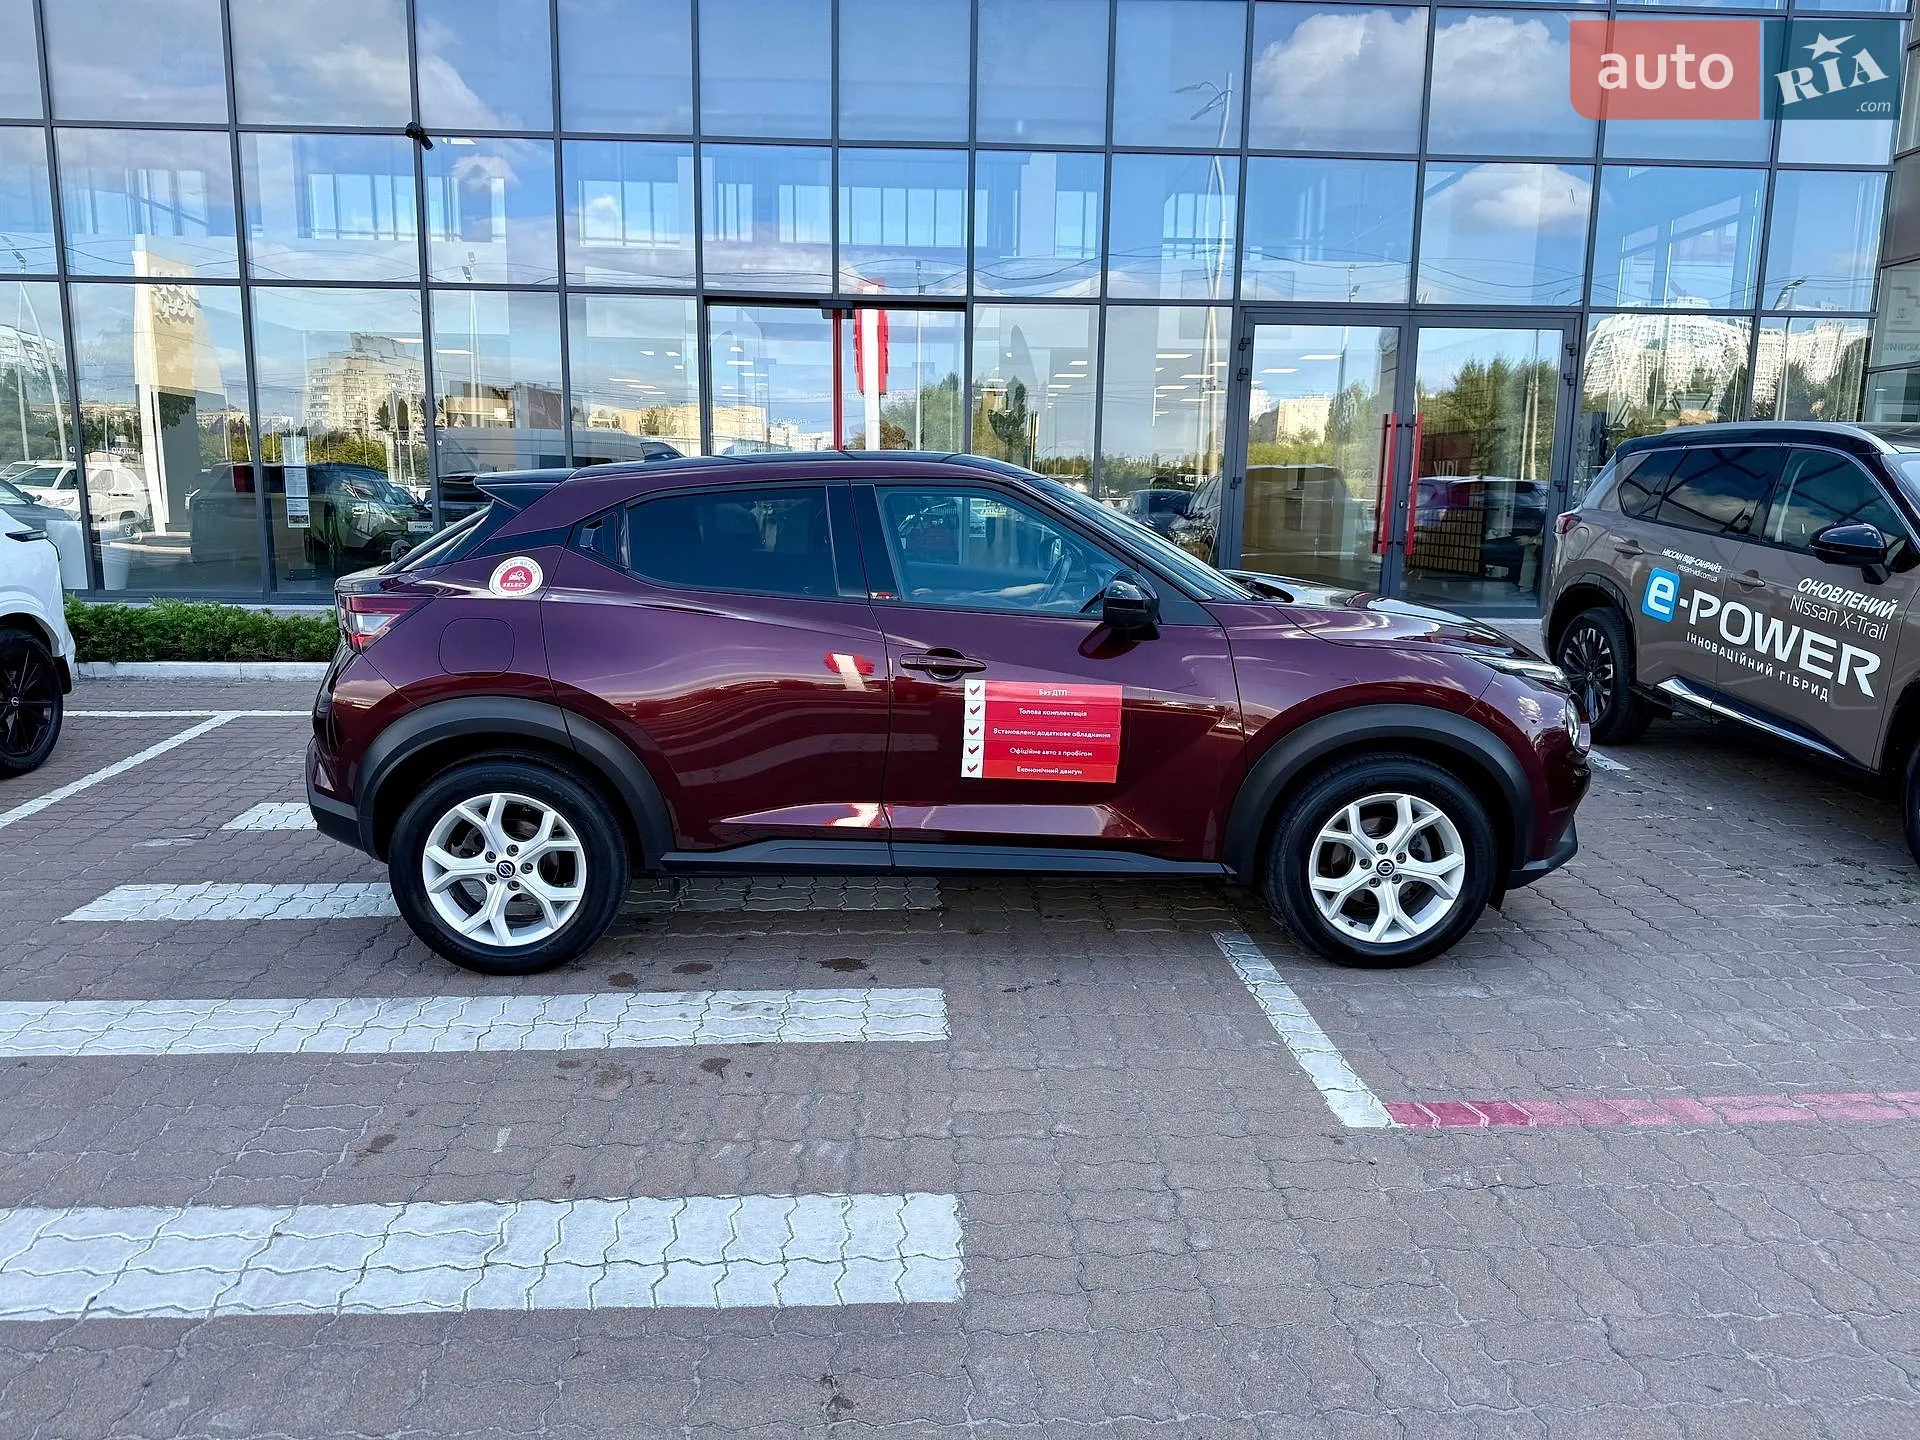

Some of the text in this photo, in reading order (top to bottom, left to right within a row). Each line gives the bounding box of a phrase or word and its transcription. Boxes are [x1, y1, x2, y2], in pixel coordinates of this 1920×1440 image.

[1797, 577, 1899, 620] ОНОВЛЕНИЙ
[1789, 594, 1889, 641] Nissan X-Trail
[1646, 576, 1881, 698] e-POWER
[1686, 631, 1829, 703] ІННОВАЦІЙНИЙ ГІБРИД
[1039, 688, 1068, 697] Без ДТП
[1018, 707, 1087, 718] Топова комплектація
[993, 728, 1111, 739] Встановлено додаткове обладнання
[1009, 747, 1041, 755] Офіційне
[1016, 765, 1083, 776] Економічний двигун
